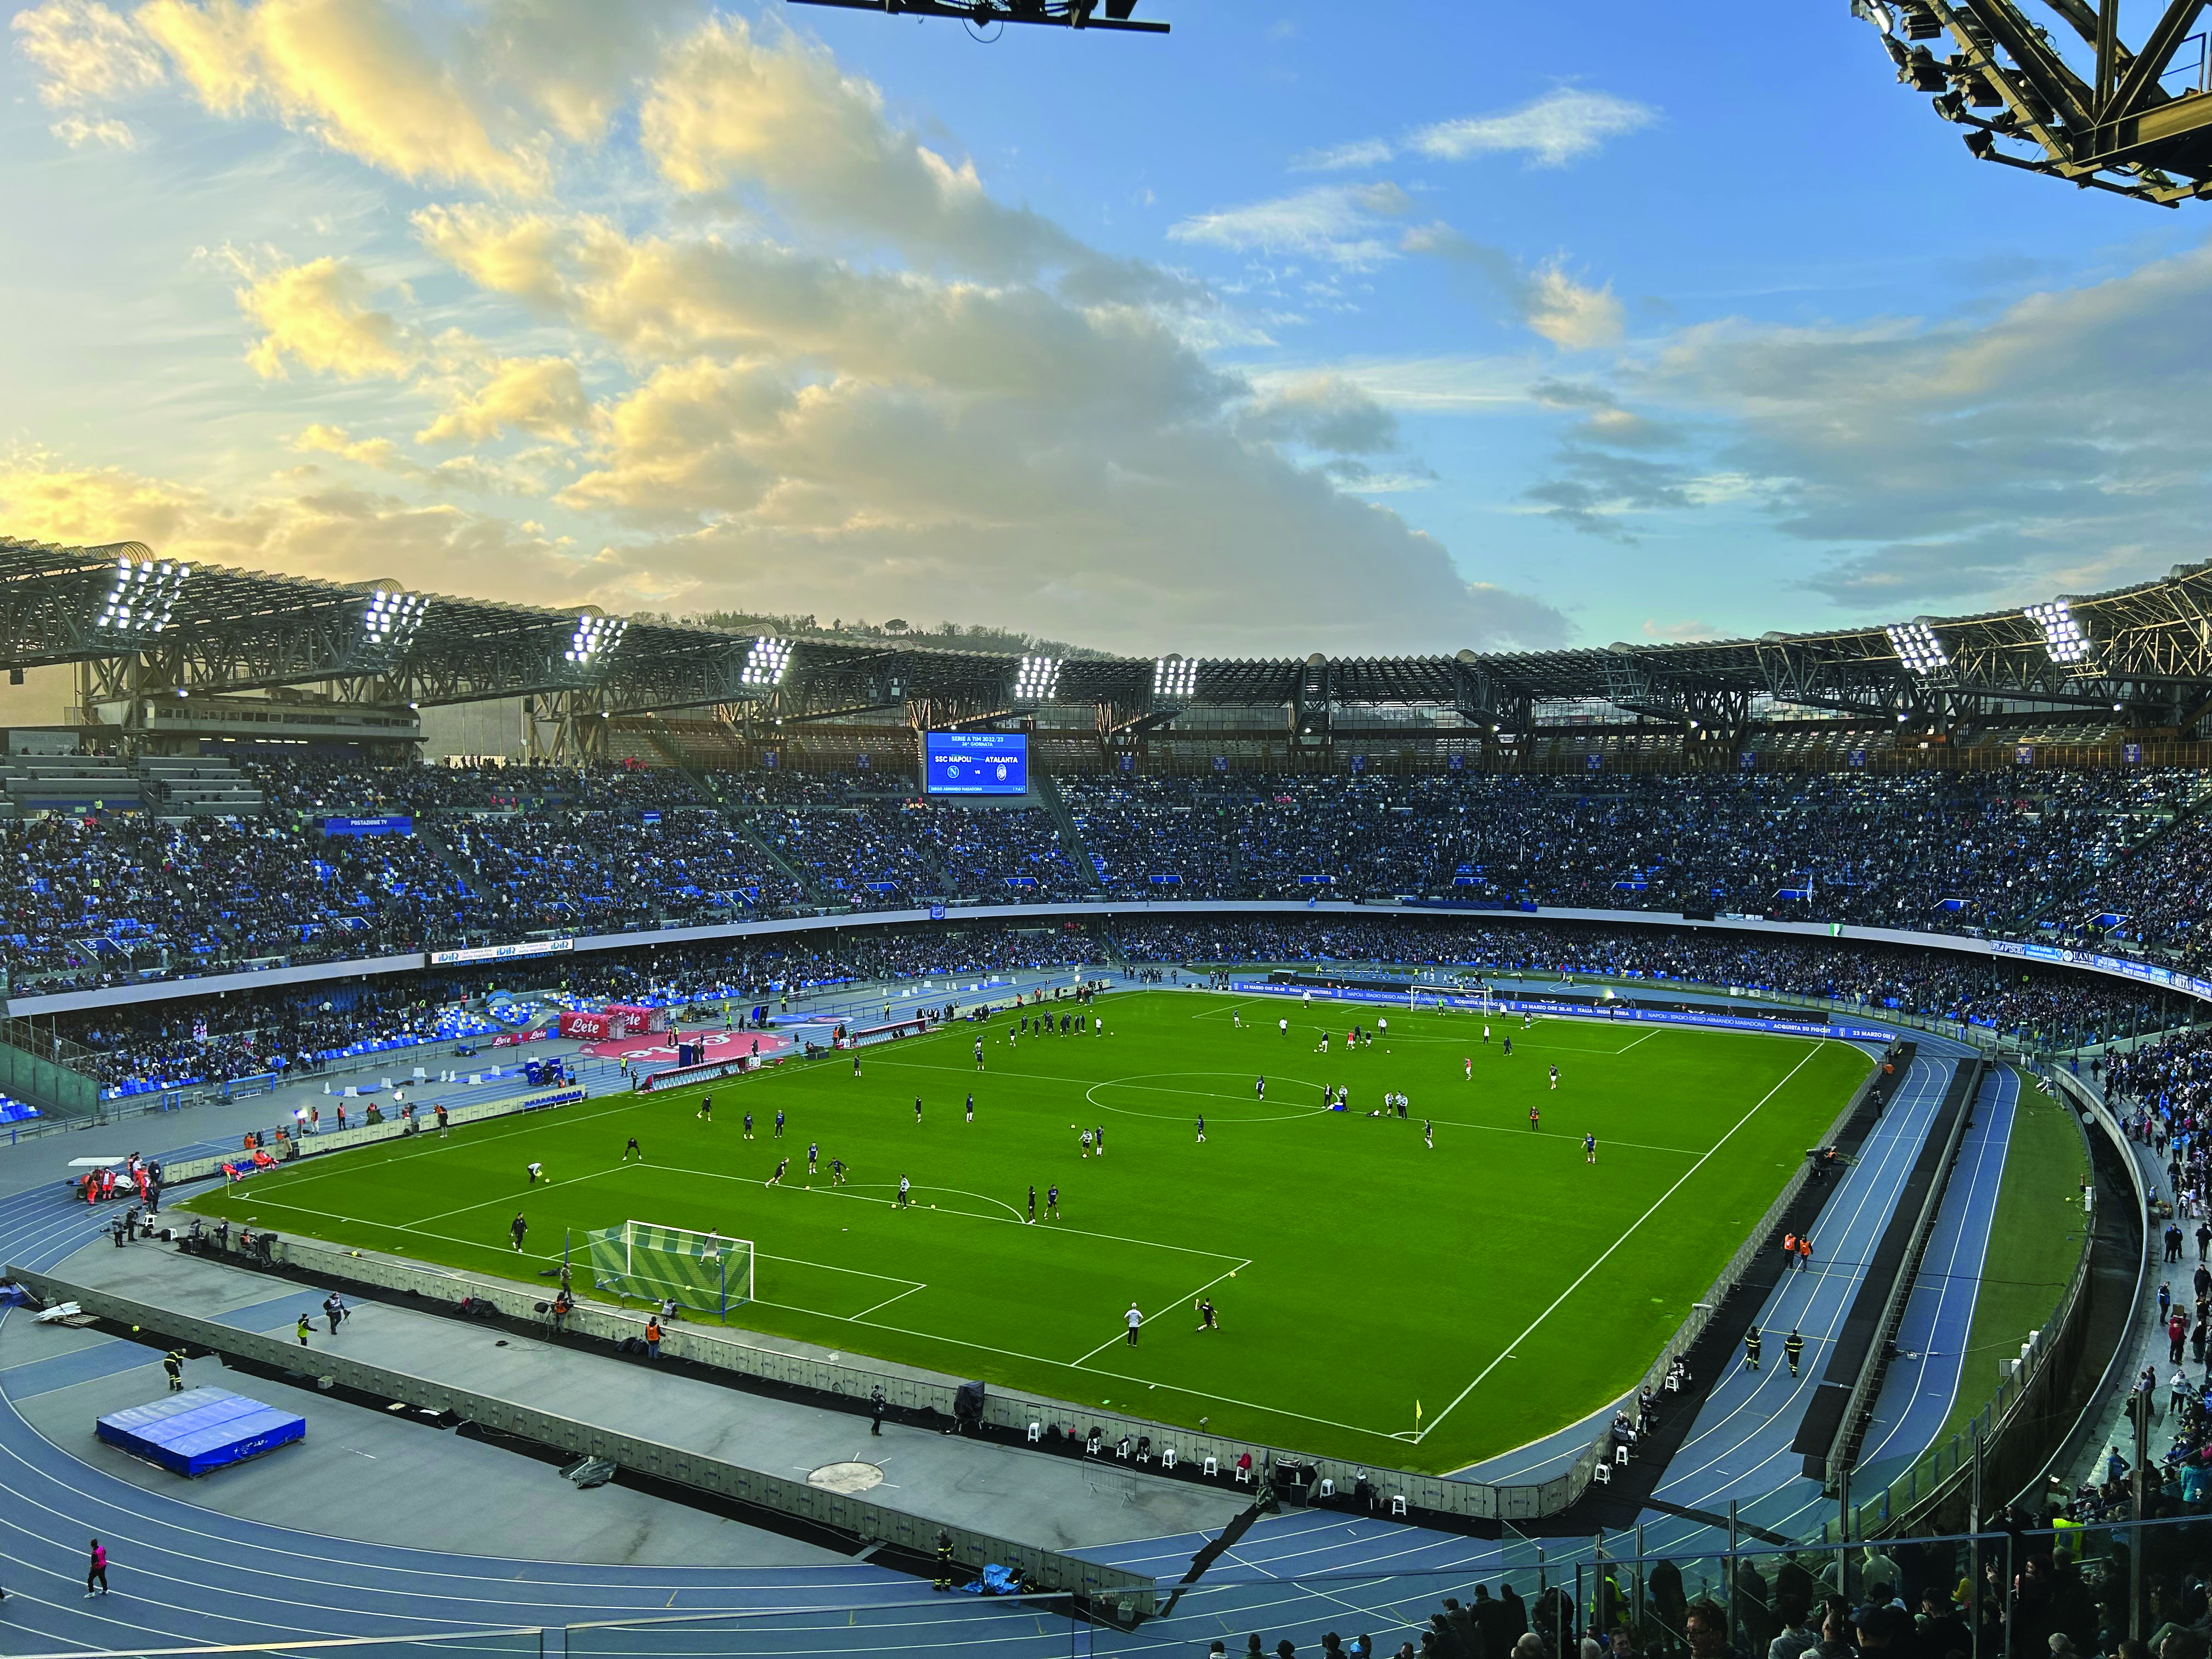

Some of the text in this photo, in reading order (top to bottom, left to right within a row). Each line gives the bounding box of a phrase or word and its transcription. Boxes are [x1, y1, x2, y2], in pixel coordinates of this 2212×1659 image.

[87, 940, 97, 949] 25
[568, 1018, 600, 1034] Lete
[529, 1030, 546, 1040] Lete
[495, 1036, 511, 1046] Lete
